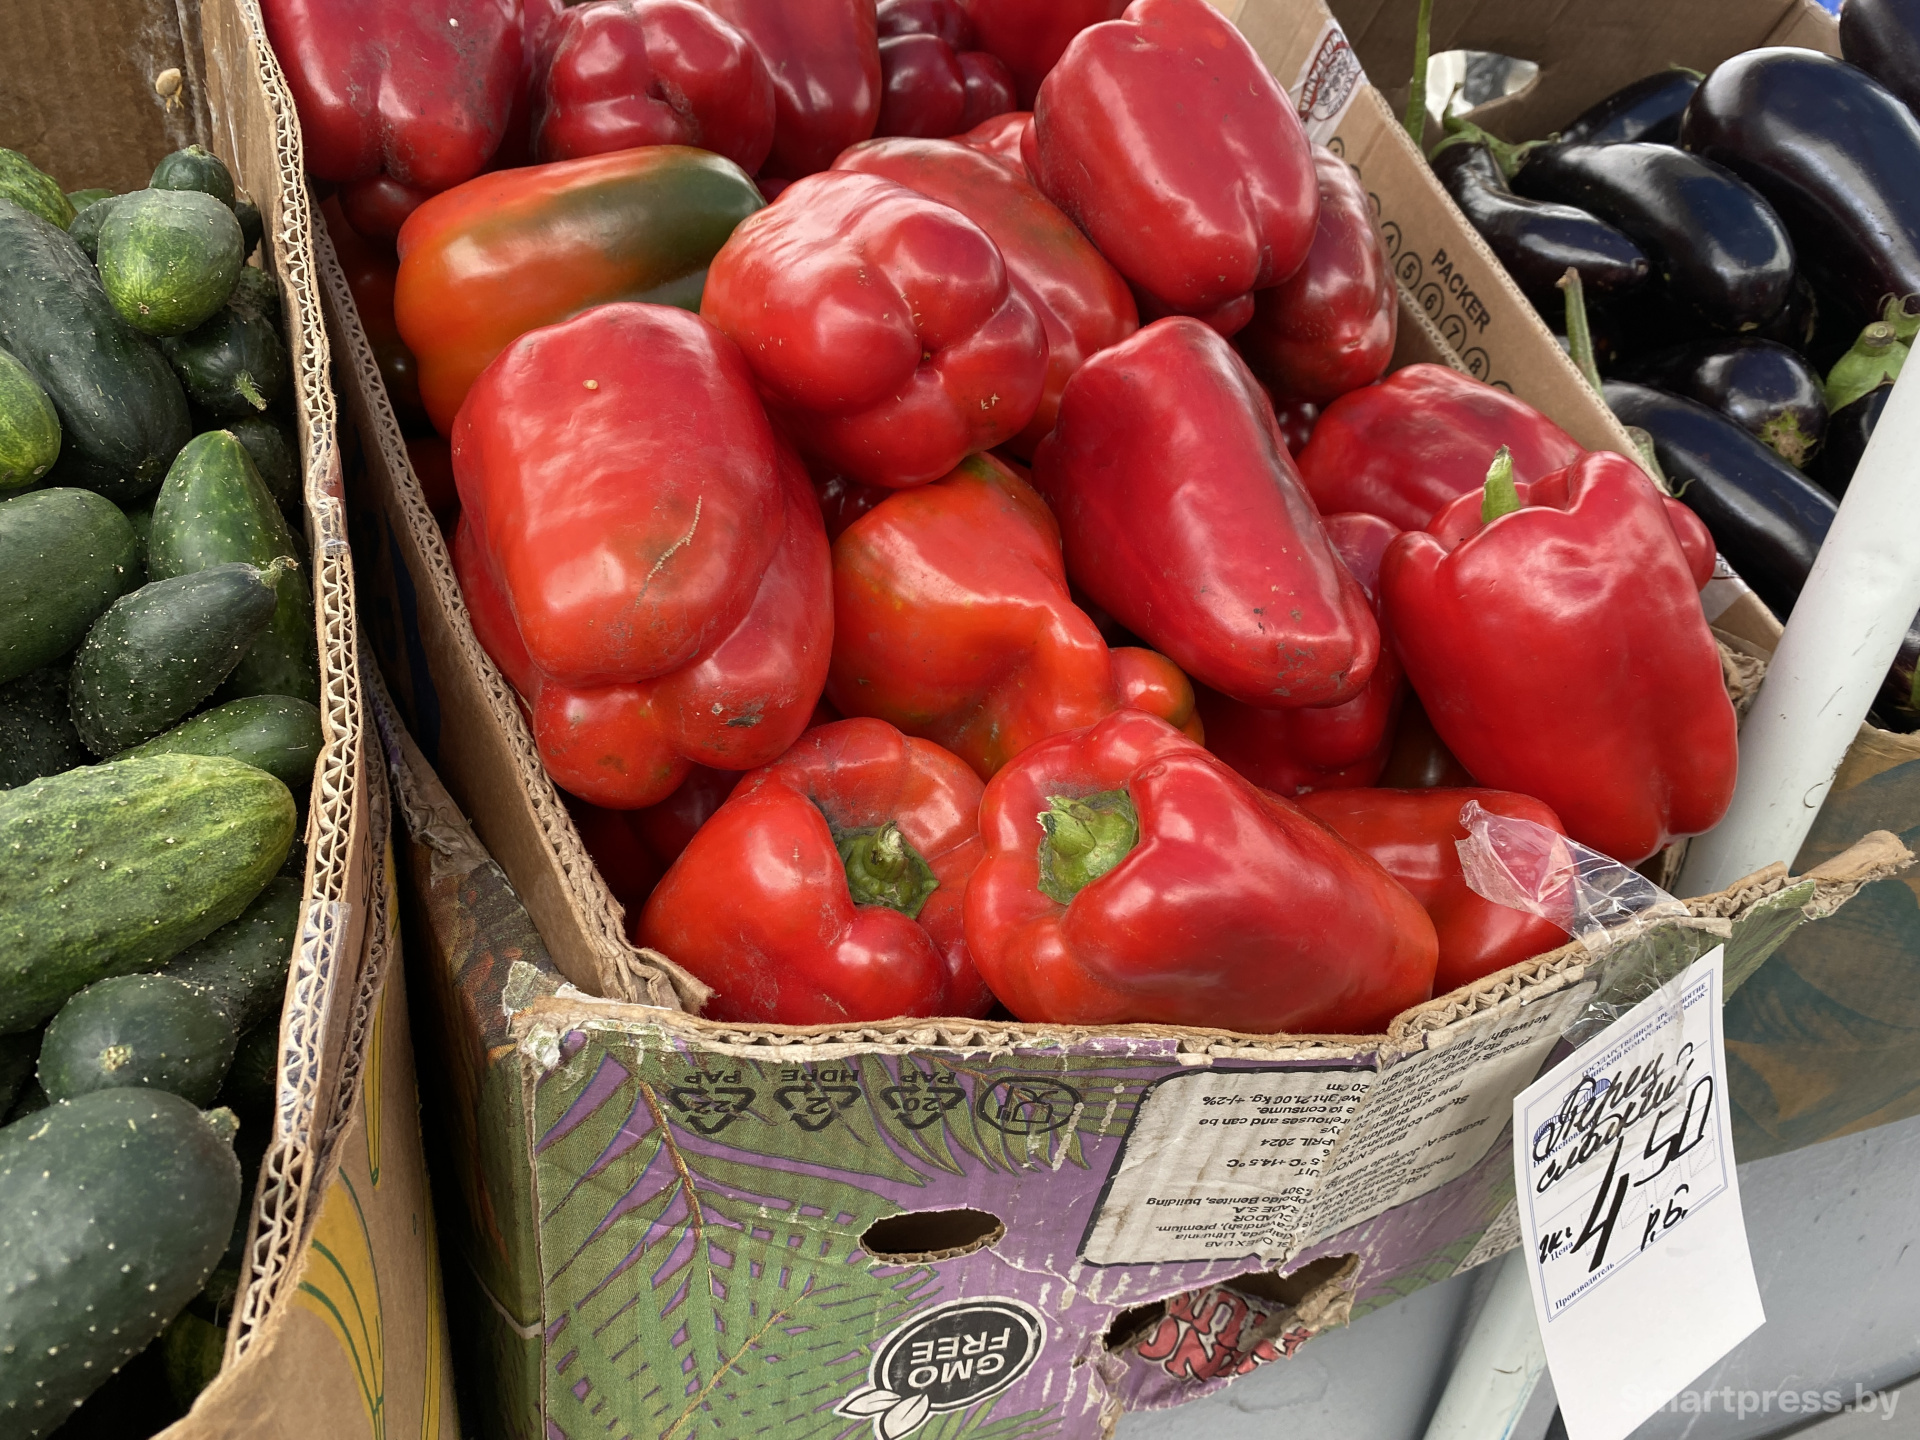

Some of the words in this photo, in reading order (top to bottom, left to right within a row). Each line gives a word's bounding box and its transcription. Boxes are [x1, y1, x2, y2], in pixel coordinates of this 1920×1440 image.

[1432, 248, 1491, 334] PACKER
[1528, 1013, 1550, 1027] Net
[684, 1071, 741, 1084] PAP
[781, 1069, 858, 1083] HDPE
[900, 1071, 956, 1083] PAP
[1327, 1083, 1350, 1092] cm
[1352, 1083, 1369, 1093] 20
[902, 1097, 937, 1112] 20
[1249, 1094, 1272, 1104] kg.
[1199, 1118, 1219, 1126] be
[1250, 1118, 1278, 1126] and
[1260, 1138, 1295, 1147] 2024
[1367, 1131, 1408, 1155] Brand:
[1251, 1158, 1286, 1167] +14.5
[1146, 1198, 1201, 1206] building
[1207, 1197, 1259, 1205] Benites,
[1156, 1224, 1216, 1232] premium.
[1551, 1242, 1573, 1261] Цена
[1555, 1263, 1615, 1309] Производитель
[910, 1327, 1010, 1364] FREE
[907, 1353, 1005, 1388] GMO
